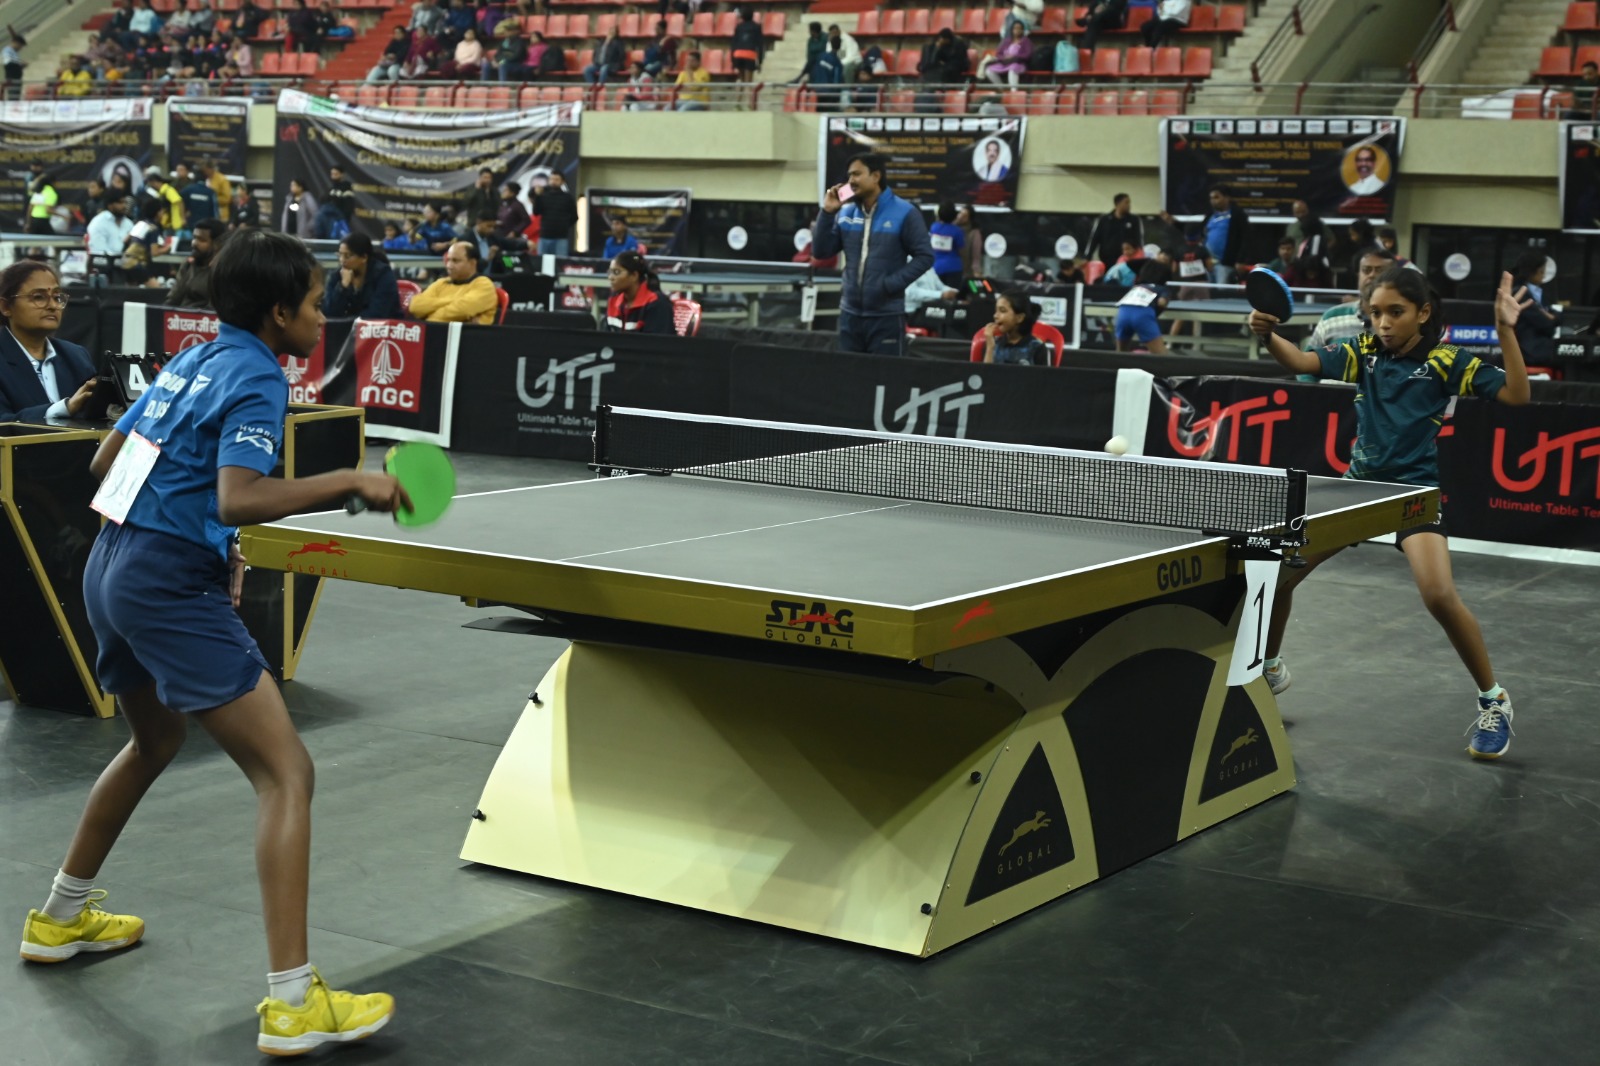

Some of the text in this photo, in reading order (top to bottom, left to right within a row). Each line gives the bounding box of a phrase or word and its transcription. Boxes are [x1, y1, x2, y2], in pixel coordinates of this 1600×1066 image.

[100, 131, 139, 146] TENNIS
[1453, 329, 1489, 340] HDFC
[128, 363, 153, 396] 4
[517, 412, 555, 424] Ultimate
[557, 414, 581, 426] Table
[1490, 497, 1542, 512] Ultimate
[1545, 502, 1579, 516] Table
[1247, 537, 1271, 546] STAG
[286, 563, 348, 578] GLOBAL
[1157, 554, 1202, 591] GOLD
[765, 599, 854, 634] STAG
[1247, 581, 1266, 671] 1
[765, 628, 854, 650] GLOBAL
[997, 844, 1051, 874] GLOBAL
